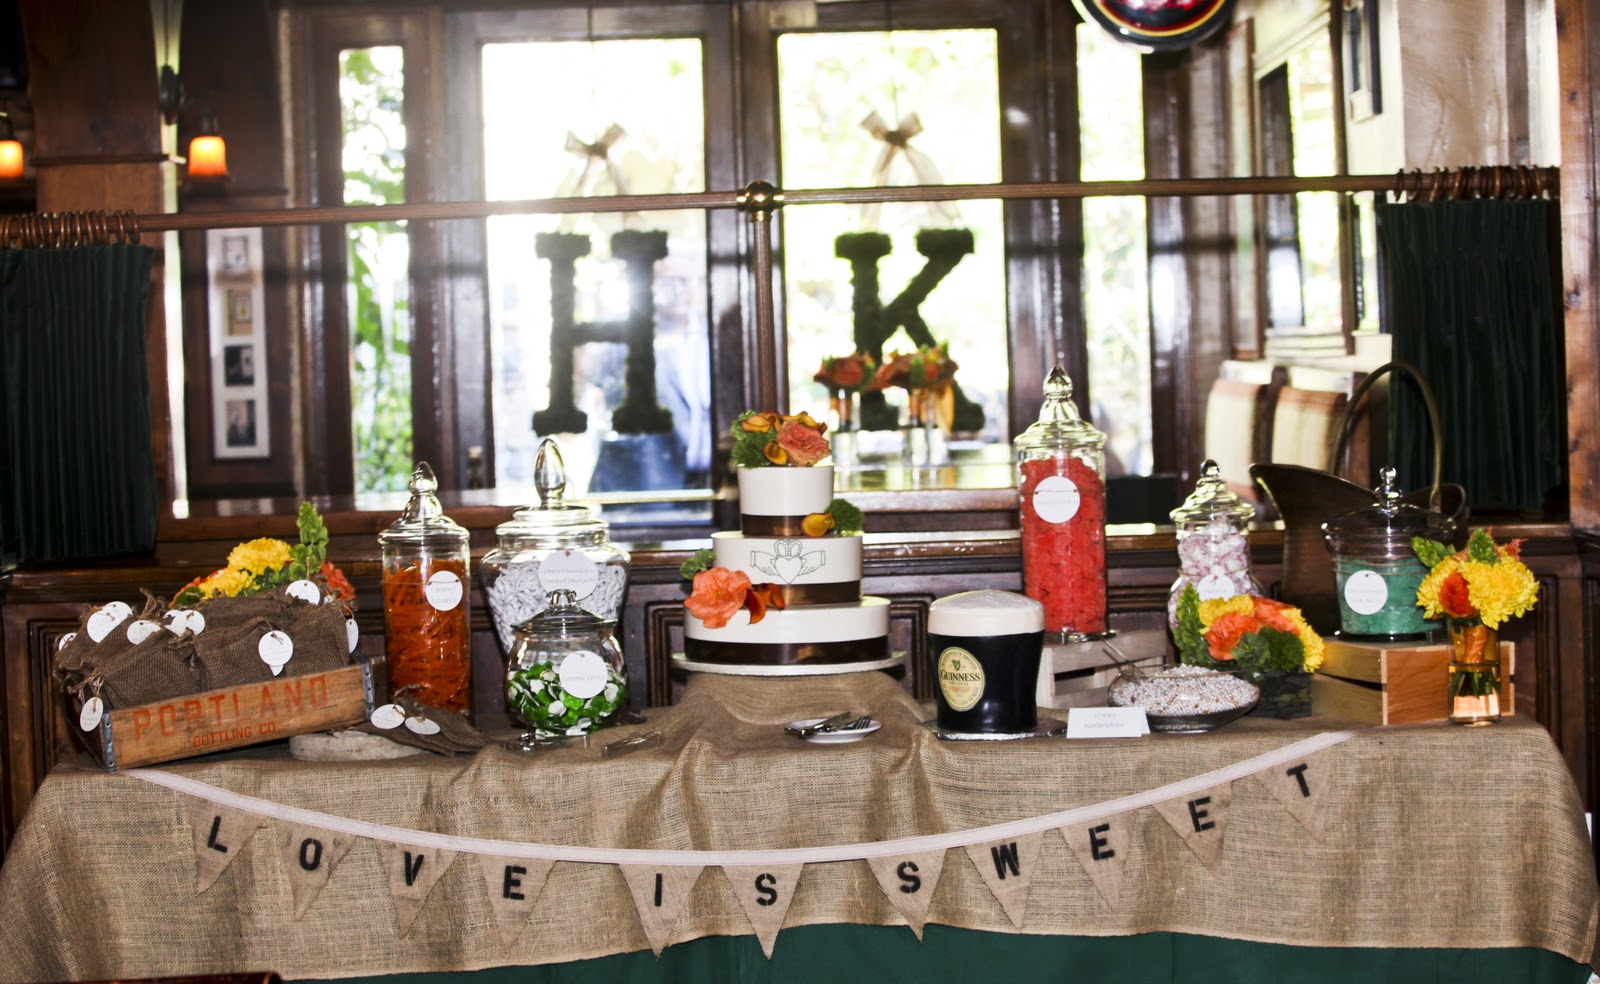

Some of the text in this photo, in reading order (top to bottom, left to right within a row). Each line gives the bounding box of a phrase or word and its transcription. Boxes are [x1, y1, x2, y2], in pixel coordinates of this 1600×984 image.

[532, 229, 673, 437] H
[834, 228, 984, 432] K
[132, 677, 330, 742] PORTLAND
[940, 669, 981, 681] GUINNESS
[193, 729, 252, 748] BOTTLING
[206, 762, 1312, 907] LOVE IS SWEET
